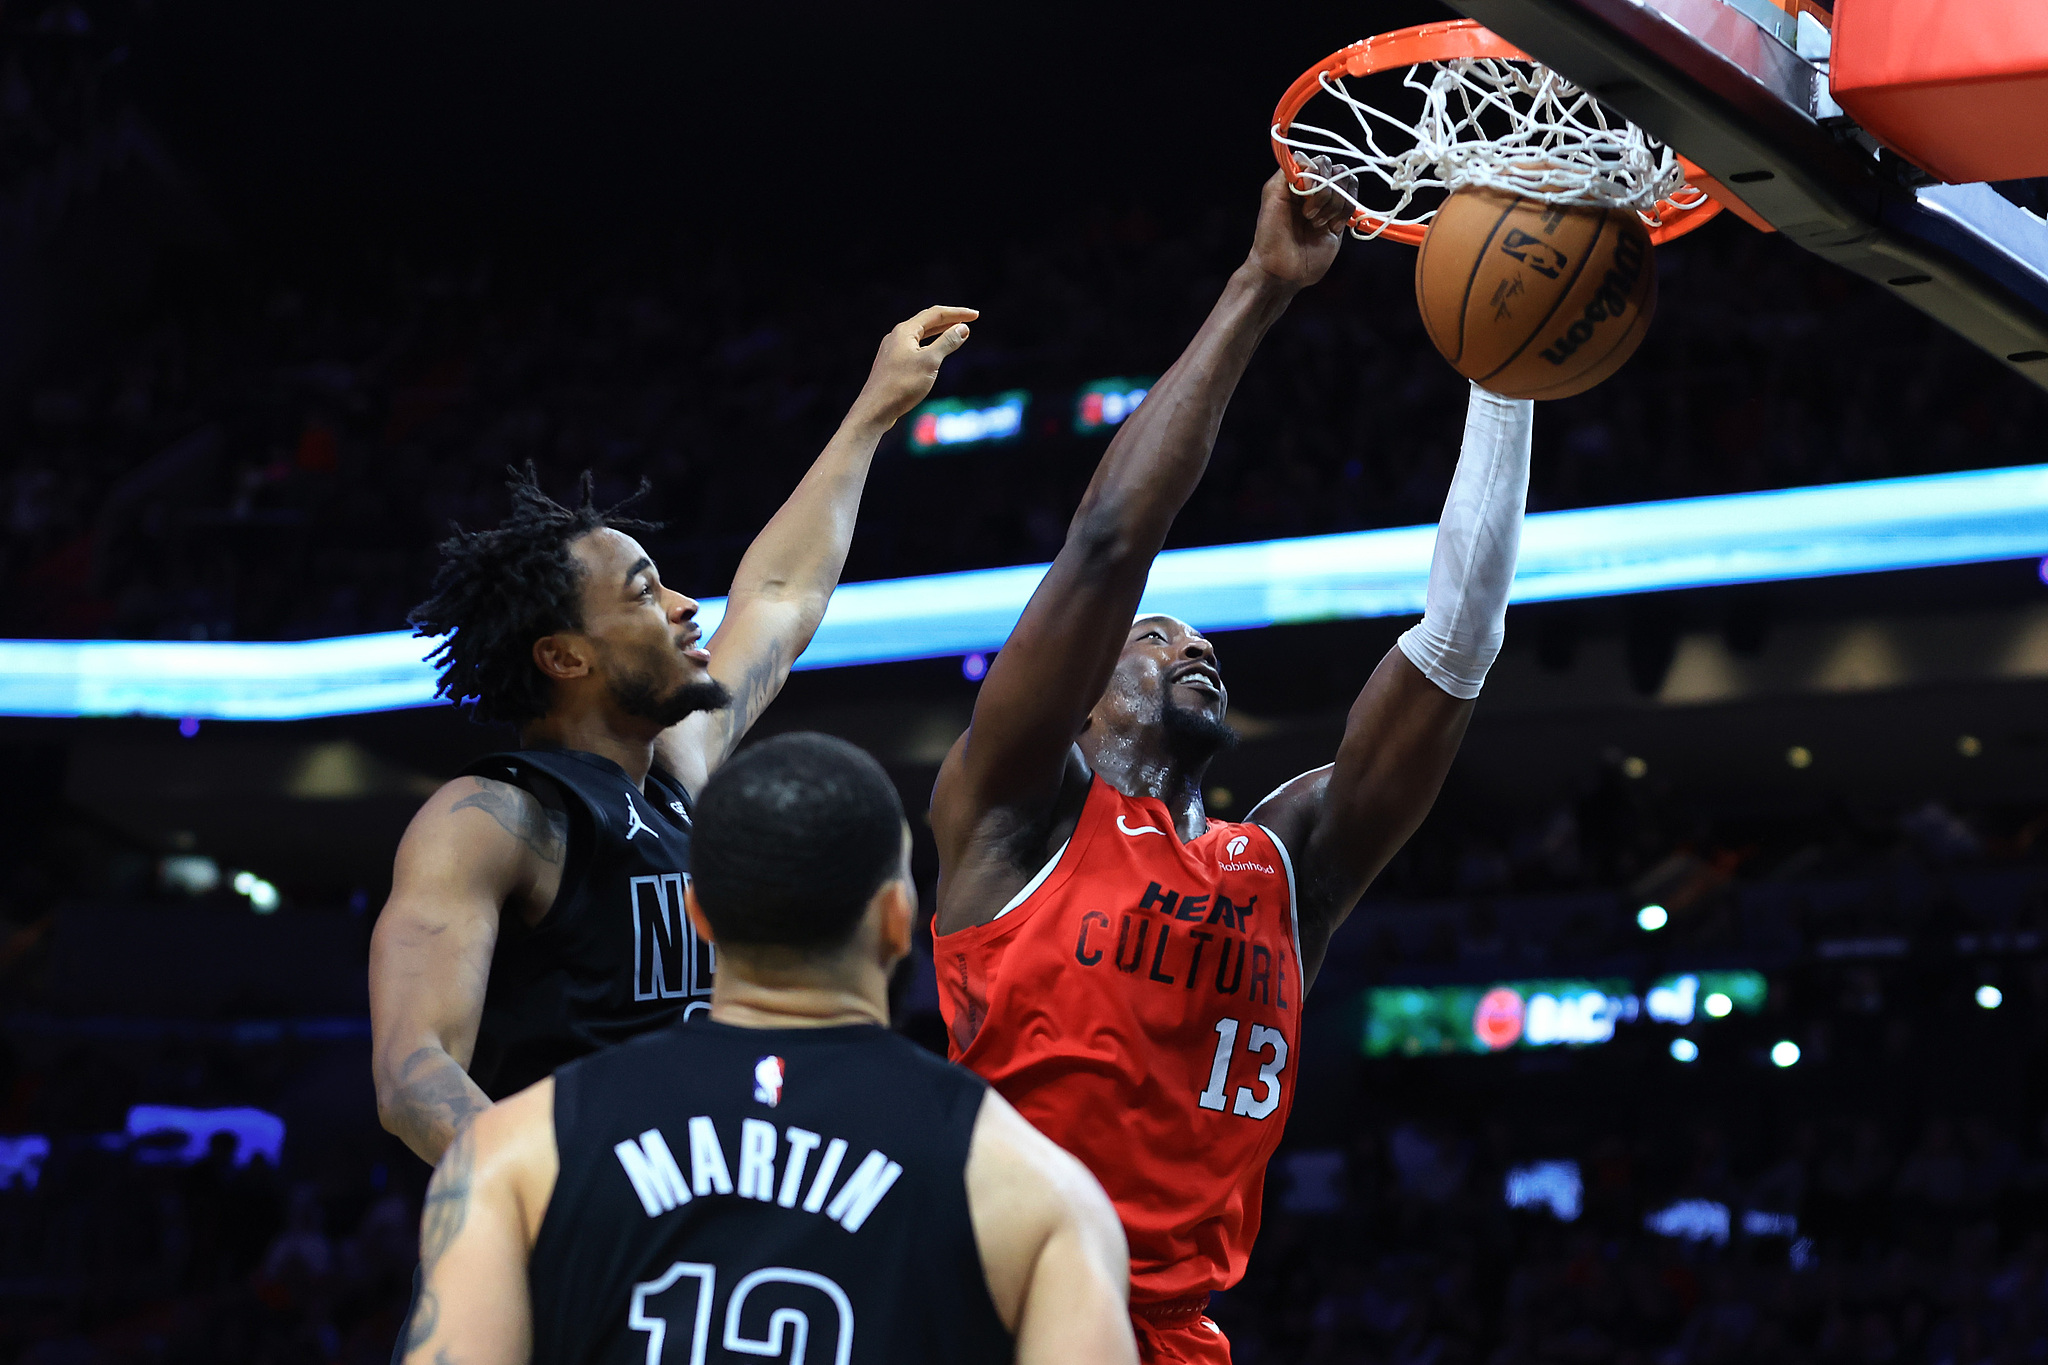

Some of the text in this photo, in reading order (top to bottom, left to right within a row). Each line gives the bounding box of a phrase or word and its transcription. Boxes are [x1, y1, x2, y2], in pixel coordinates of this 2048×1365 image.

[1139, 881, 1258, 934] HEAT
[1218, 860, 1275, 875] Robinhood
[1075, 909, 1289, 1011] CULTURE
[1198, 1016, 1291, 1122] 13
[613, 1115, 904, 1234] MARTIN
